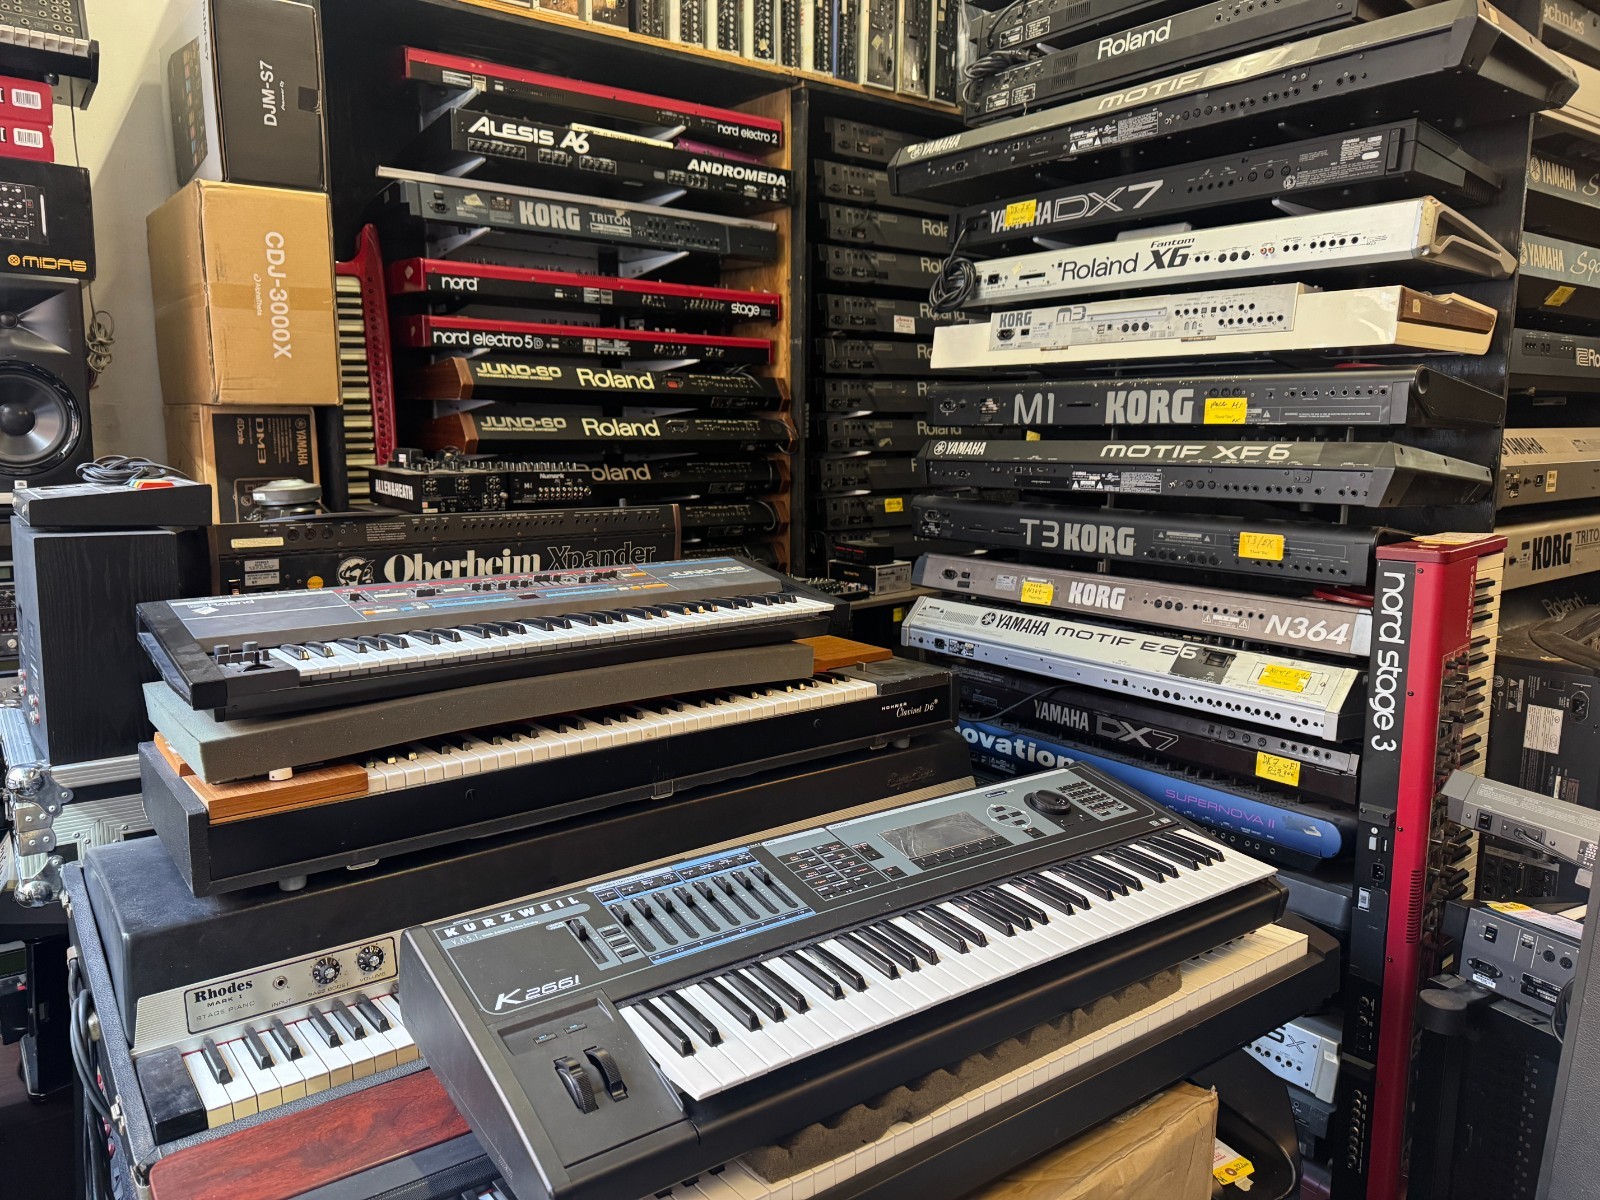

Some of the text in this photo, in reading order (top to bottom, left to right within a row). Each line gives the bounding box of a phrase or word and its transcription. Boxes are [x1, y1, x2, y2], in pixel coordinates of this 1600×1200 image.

[1097, 20, 1172, 60] Roland
[260, 60, 278, 127] DJM-S7
[1098, 72, 1203, 111] MOTIF
[468, 116, 590, 154] ALESIS A6
[717, 123, 778, 143] nord electro 2
[922, 134, 962, 156] YAMAHA
[687, 158, 787, 187] ANDROMEDA
[1541, 160, 1577, 193] YAMAHA
[519, 200, 581, 231] KORG
[1053, 180, 1163, 222] DX7
[589, 212, 631, 226] TRITON
[1150, 237, 1195, 249] Fantom
[1528, 243, 1565, 272] YAMAHA
[22, 255, 87, 272] MIDAS
[1062, 245, 1192, 281] Roland X6
[265, 231, 293, 359] CDJ-3000X
[442, 276, 479, 291] nord
[731, 302, 760, 317] stage
[1000, 311, 1032, 328] KORG
[433, 331, 469, 345] nord
[473, 332, 523, 348] electro
[476, 362, 655, 390] JUNO-60 Roland
[1013, 389, 1194, 424] M1 KORG
[256, 418, 267, 464] DM3
[481, 416, 660, 436] JUNO-60 Roland
[297, 429, 309, 466] YAMAHA
[946, 441, 1293, 460] YAMAHA MOTIF XF6
[1505, 437, 1547, 455] YAMAHA
[375, 479, 414, 500] ALLEN&HEATH
[1020, 518, 1135, 556] T3 KORG
[1532, 532, 1572, 571] KORG
[384, 541, 656, 583] Oberheim Xpander
[1068, 581, 1350, 645] KORG N364
[1542, 592, 1584, 618] Roland
[995, 613, 1200, 660] YAMAHA MOTIF ES6
[1368, 571, 1406, 752] nord stage 3
[1034, 700, 1179, 752] YAMAHA DX7
[1165, 789, 1275, 828] SUPERNOVA II
[444, 896, 580, 938] KURZWEIL
[193, 980, 253, 1003] Rhodes
[207, 997, 233, 1008] MARK
[227, 1000, 256, 1013] PIANO
[271, 998, 293, 1008] INPUT
[494, 974, 581, 1011] K2661
